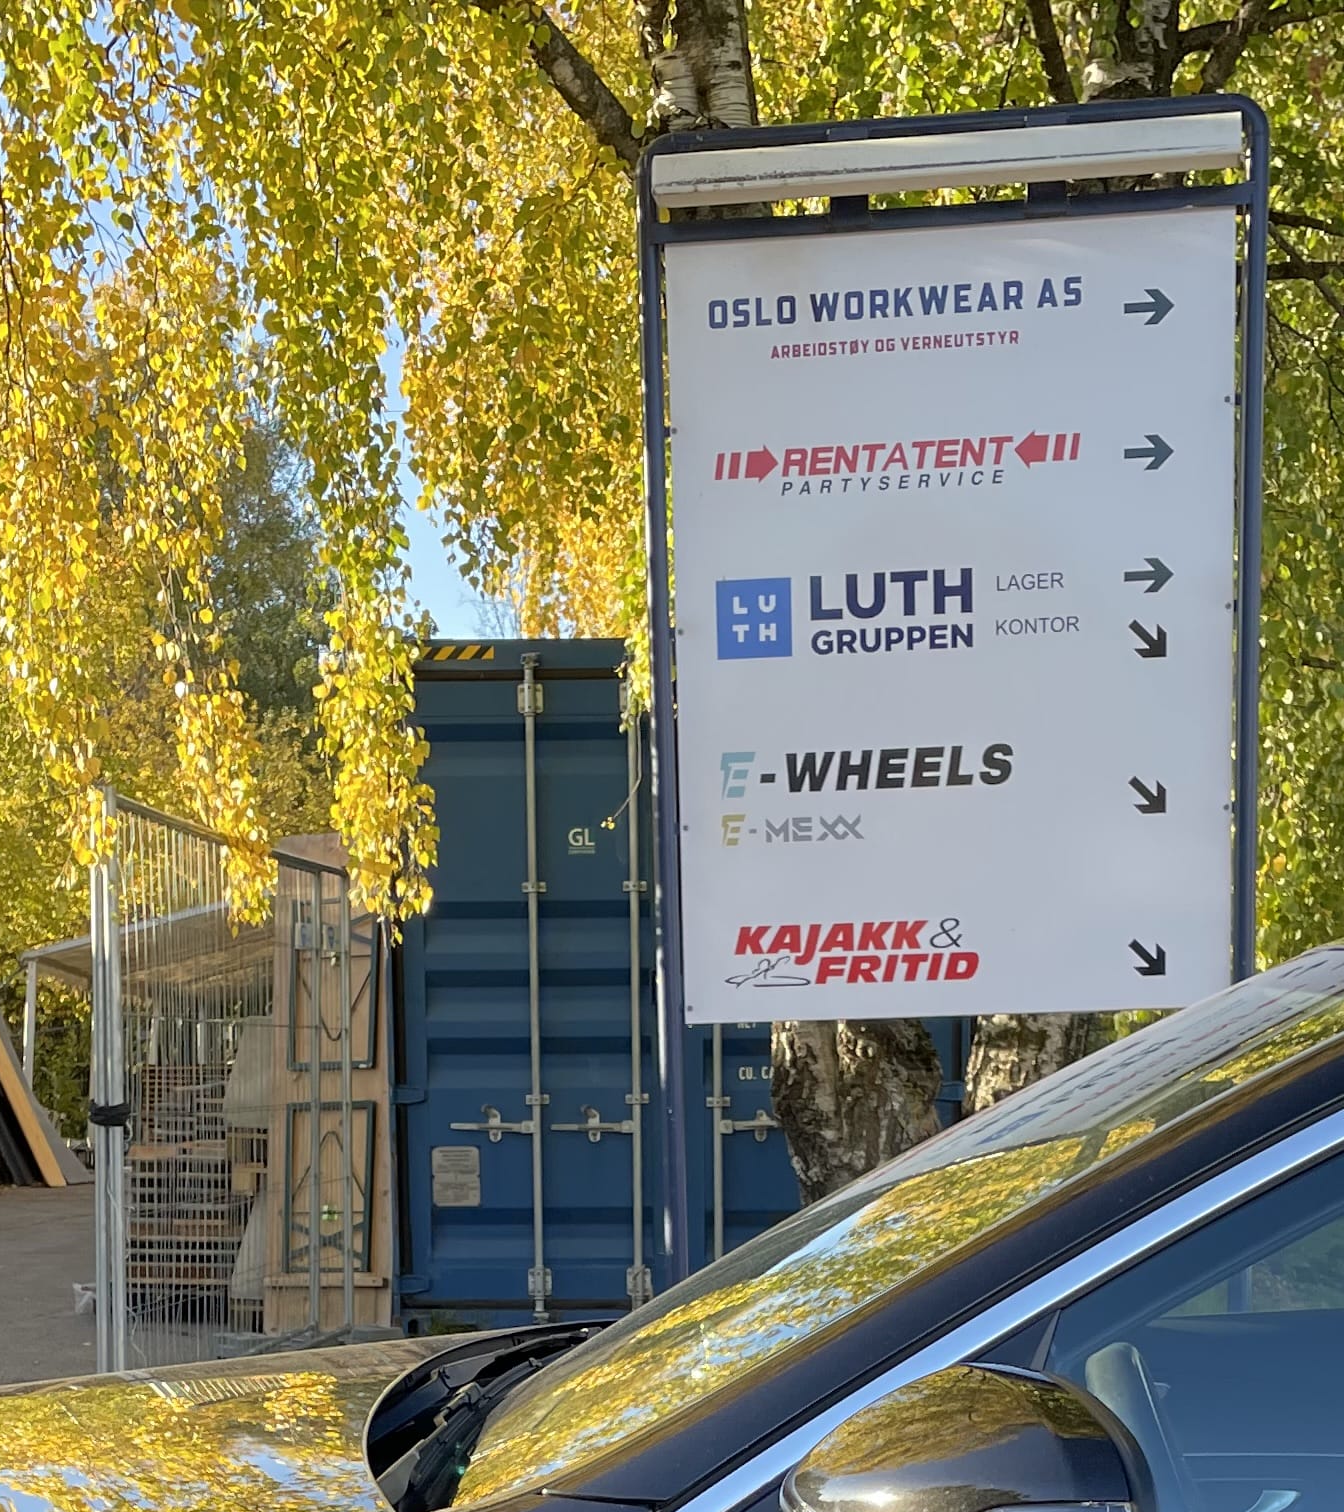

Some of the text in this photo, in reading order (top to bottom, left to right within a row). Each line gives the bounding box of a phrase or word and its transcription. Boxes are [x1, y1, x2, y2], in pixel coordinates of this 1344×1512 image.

[708, 276, 1082, 329] OSLO WORKWEAR AS
[875, 337, 896, 352] OG
[900, 330, 1020, 352] VERNEUTSTYR
[782, 436, 1014, 477] RENTATENT
[781, 469, 1005, 496] PARTYSERVICE
[810, 568, 1064, 620] LUTH LAGER
[811, 615, 1080, 655] GRUPPEN KONTOR
[720, 743, 1014, 800] E-WHEELS
[568, 827, 596, 846] GL
[734, 917, 962, 965] KAJAKK &
[815, 952, 980, 985] FRITID
[761, 1066, 775, 1080] CA
